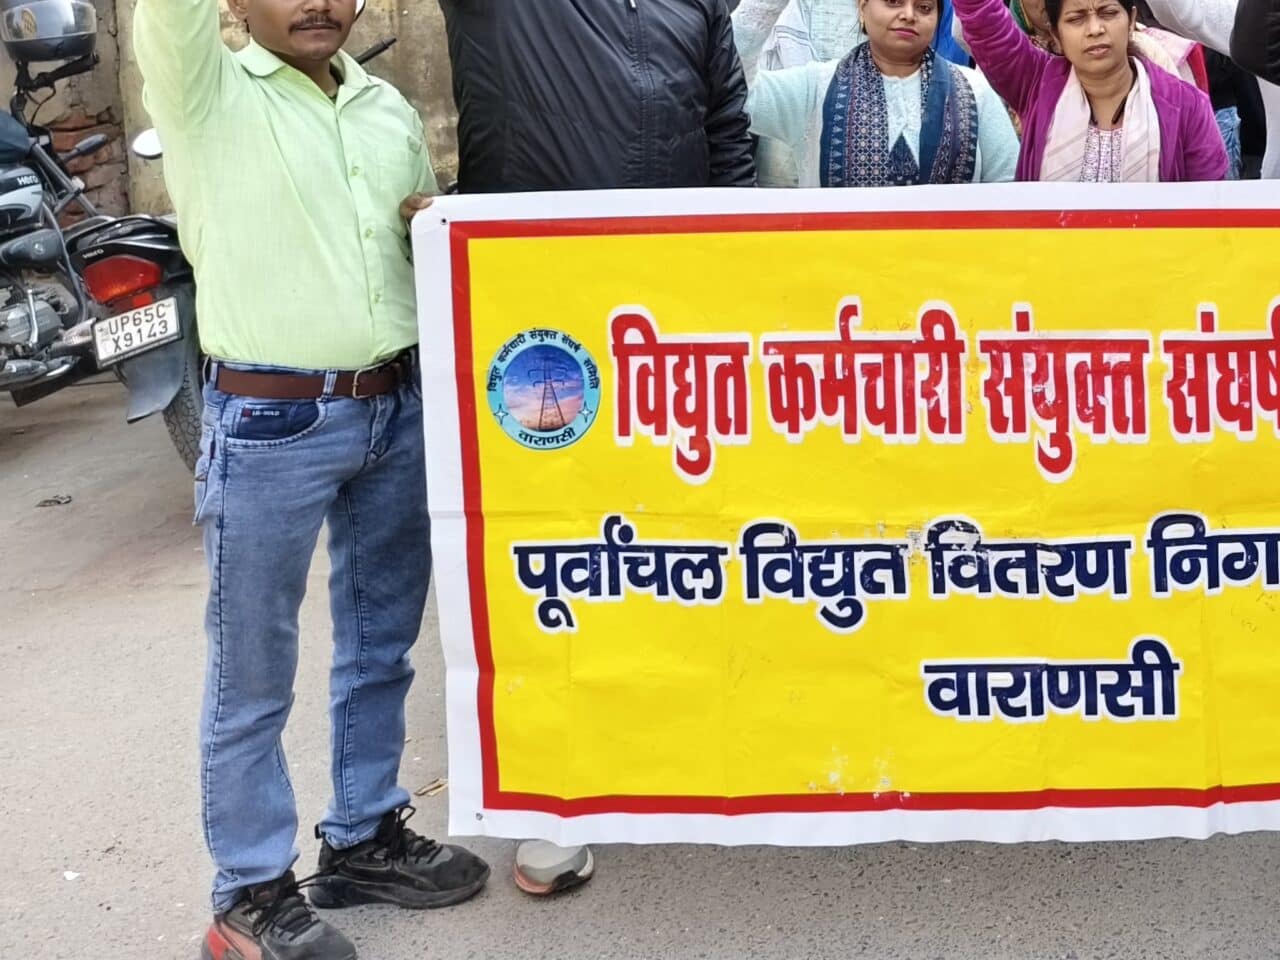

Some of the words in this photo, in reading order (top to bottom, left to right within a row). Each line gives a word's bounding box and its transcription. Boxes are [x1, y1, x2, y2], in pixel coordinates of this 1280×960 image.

[108, 303, 167, 335] UP65C
[112, 320, 168, 353] X9143
[610, 312, 751, 476] विद्युत
[763, 303, 966, 436] कर्मचारी
[979, 311, 1150, 474] संयुक्त
[517, 426, 577, 446] वाराणसी
[512, 515, 729, 628] पूर्वांचल
[740, 521, 909, 627] विद्युत
[925, 519, 1131, 597] वितरण
[924, 639, 1181, 718] वाराणसी
